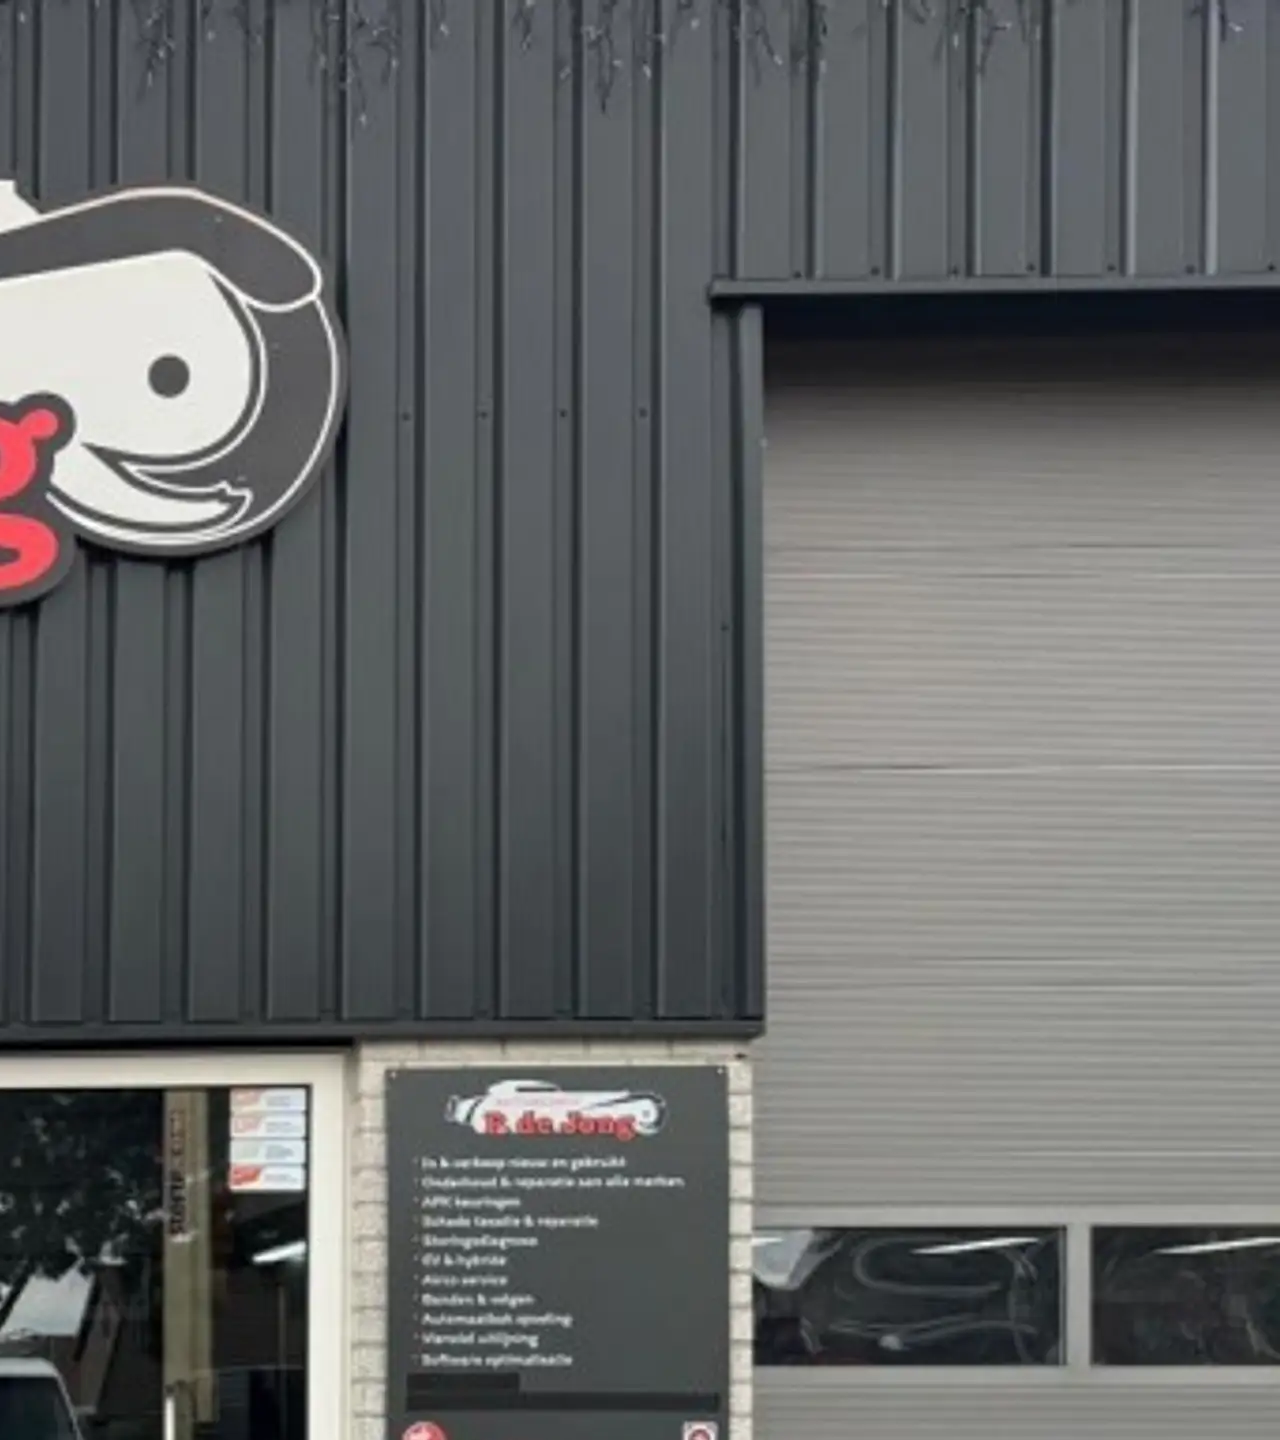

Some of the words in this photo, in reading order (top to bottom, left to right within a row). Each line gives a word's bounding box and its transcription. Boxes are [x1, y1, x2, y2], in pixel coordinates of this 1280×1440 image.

[516, 1110, 553, 1136] de
[560, 1110, 637, 1141] Jong
[571, 1157, 626, 1171] gebruikt
